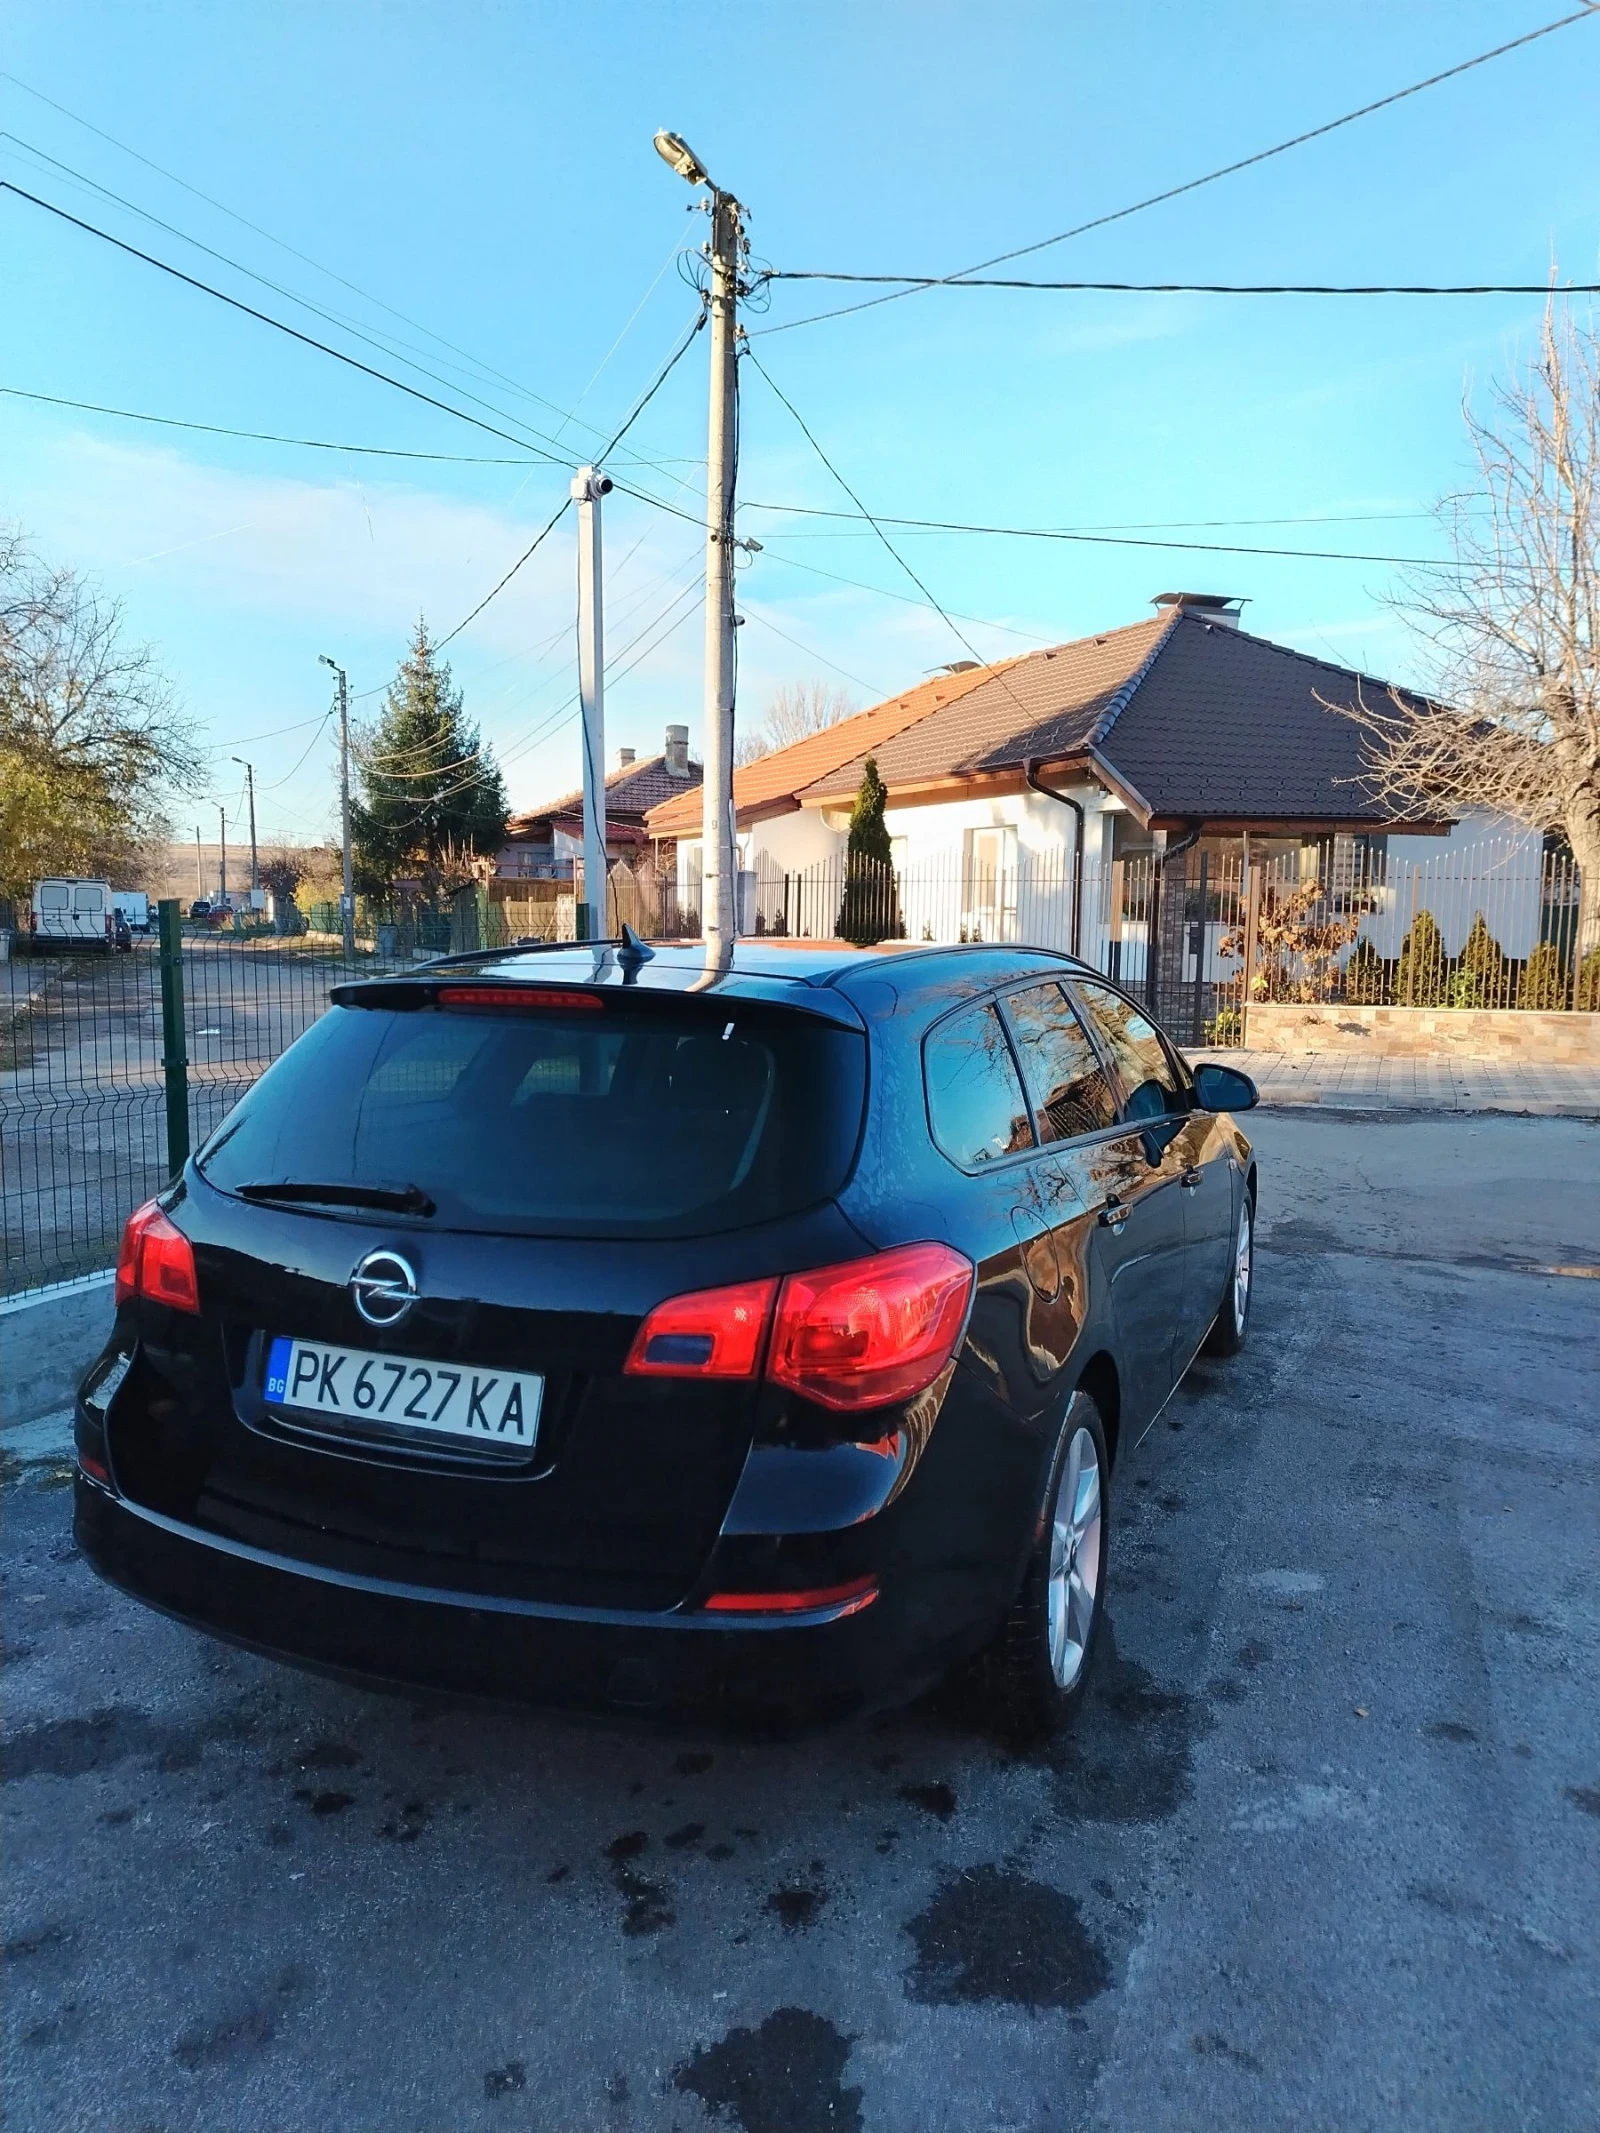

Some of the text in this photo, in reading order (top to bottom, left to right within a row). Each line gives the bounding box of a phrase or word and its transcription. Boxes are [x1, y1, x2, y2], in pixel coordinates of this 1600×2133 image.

[268, 1377, 285, 1394] BG
[291, 1349, 524, 1436] PK 6727 KA
